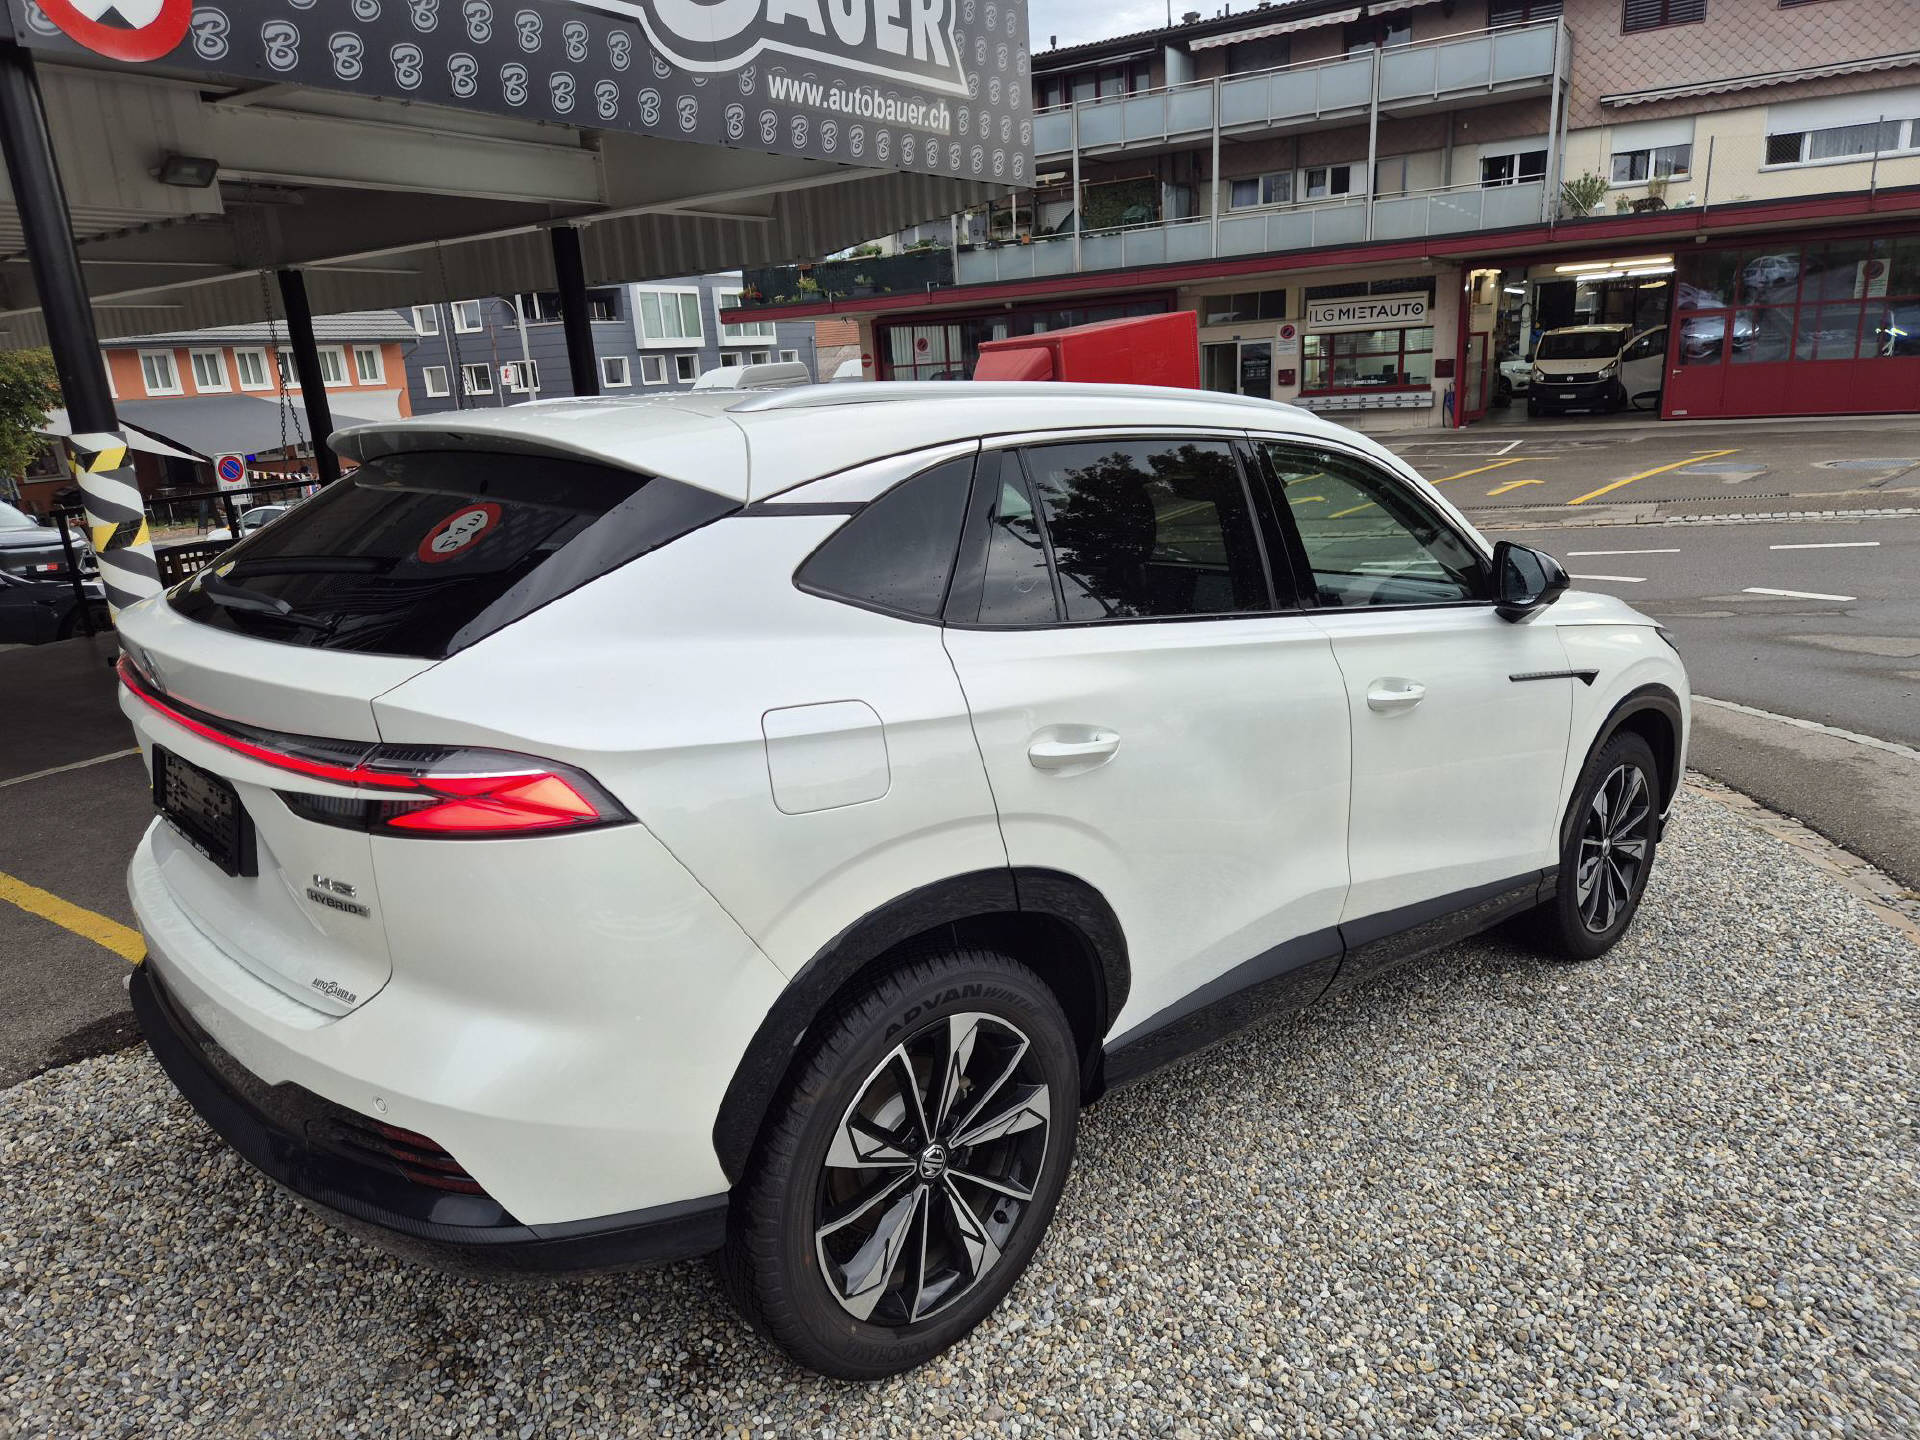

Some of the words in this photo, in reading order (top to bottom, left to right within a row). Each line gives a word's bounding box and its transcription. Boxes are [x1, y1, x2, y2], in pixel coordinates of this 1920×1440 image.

[768, 75, 950, 130] www.autobauer.ch
[1309, 309, 1335, 323] ILG
[1339, 303, 1424, 320] MIETAUTO
[884, 983, 983, 1044] ADVAN
